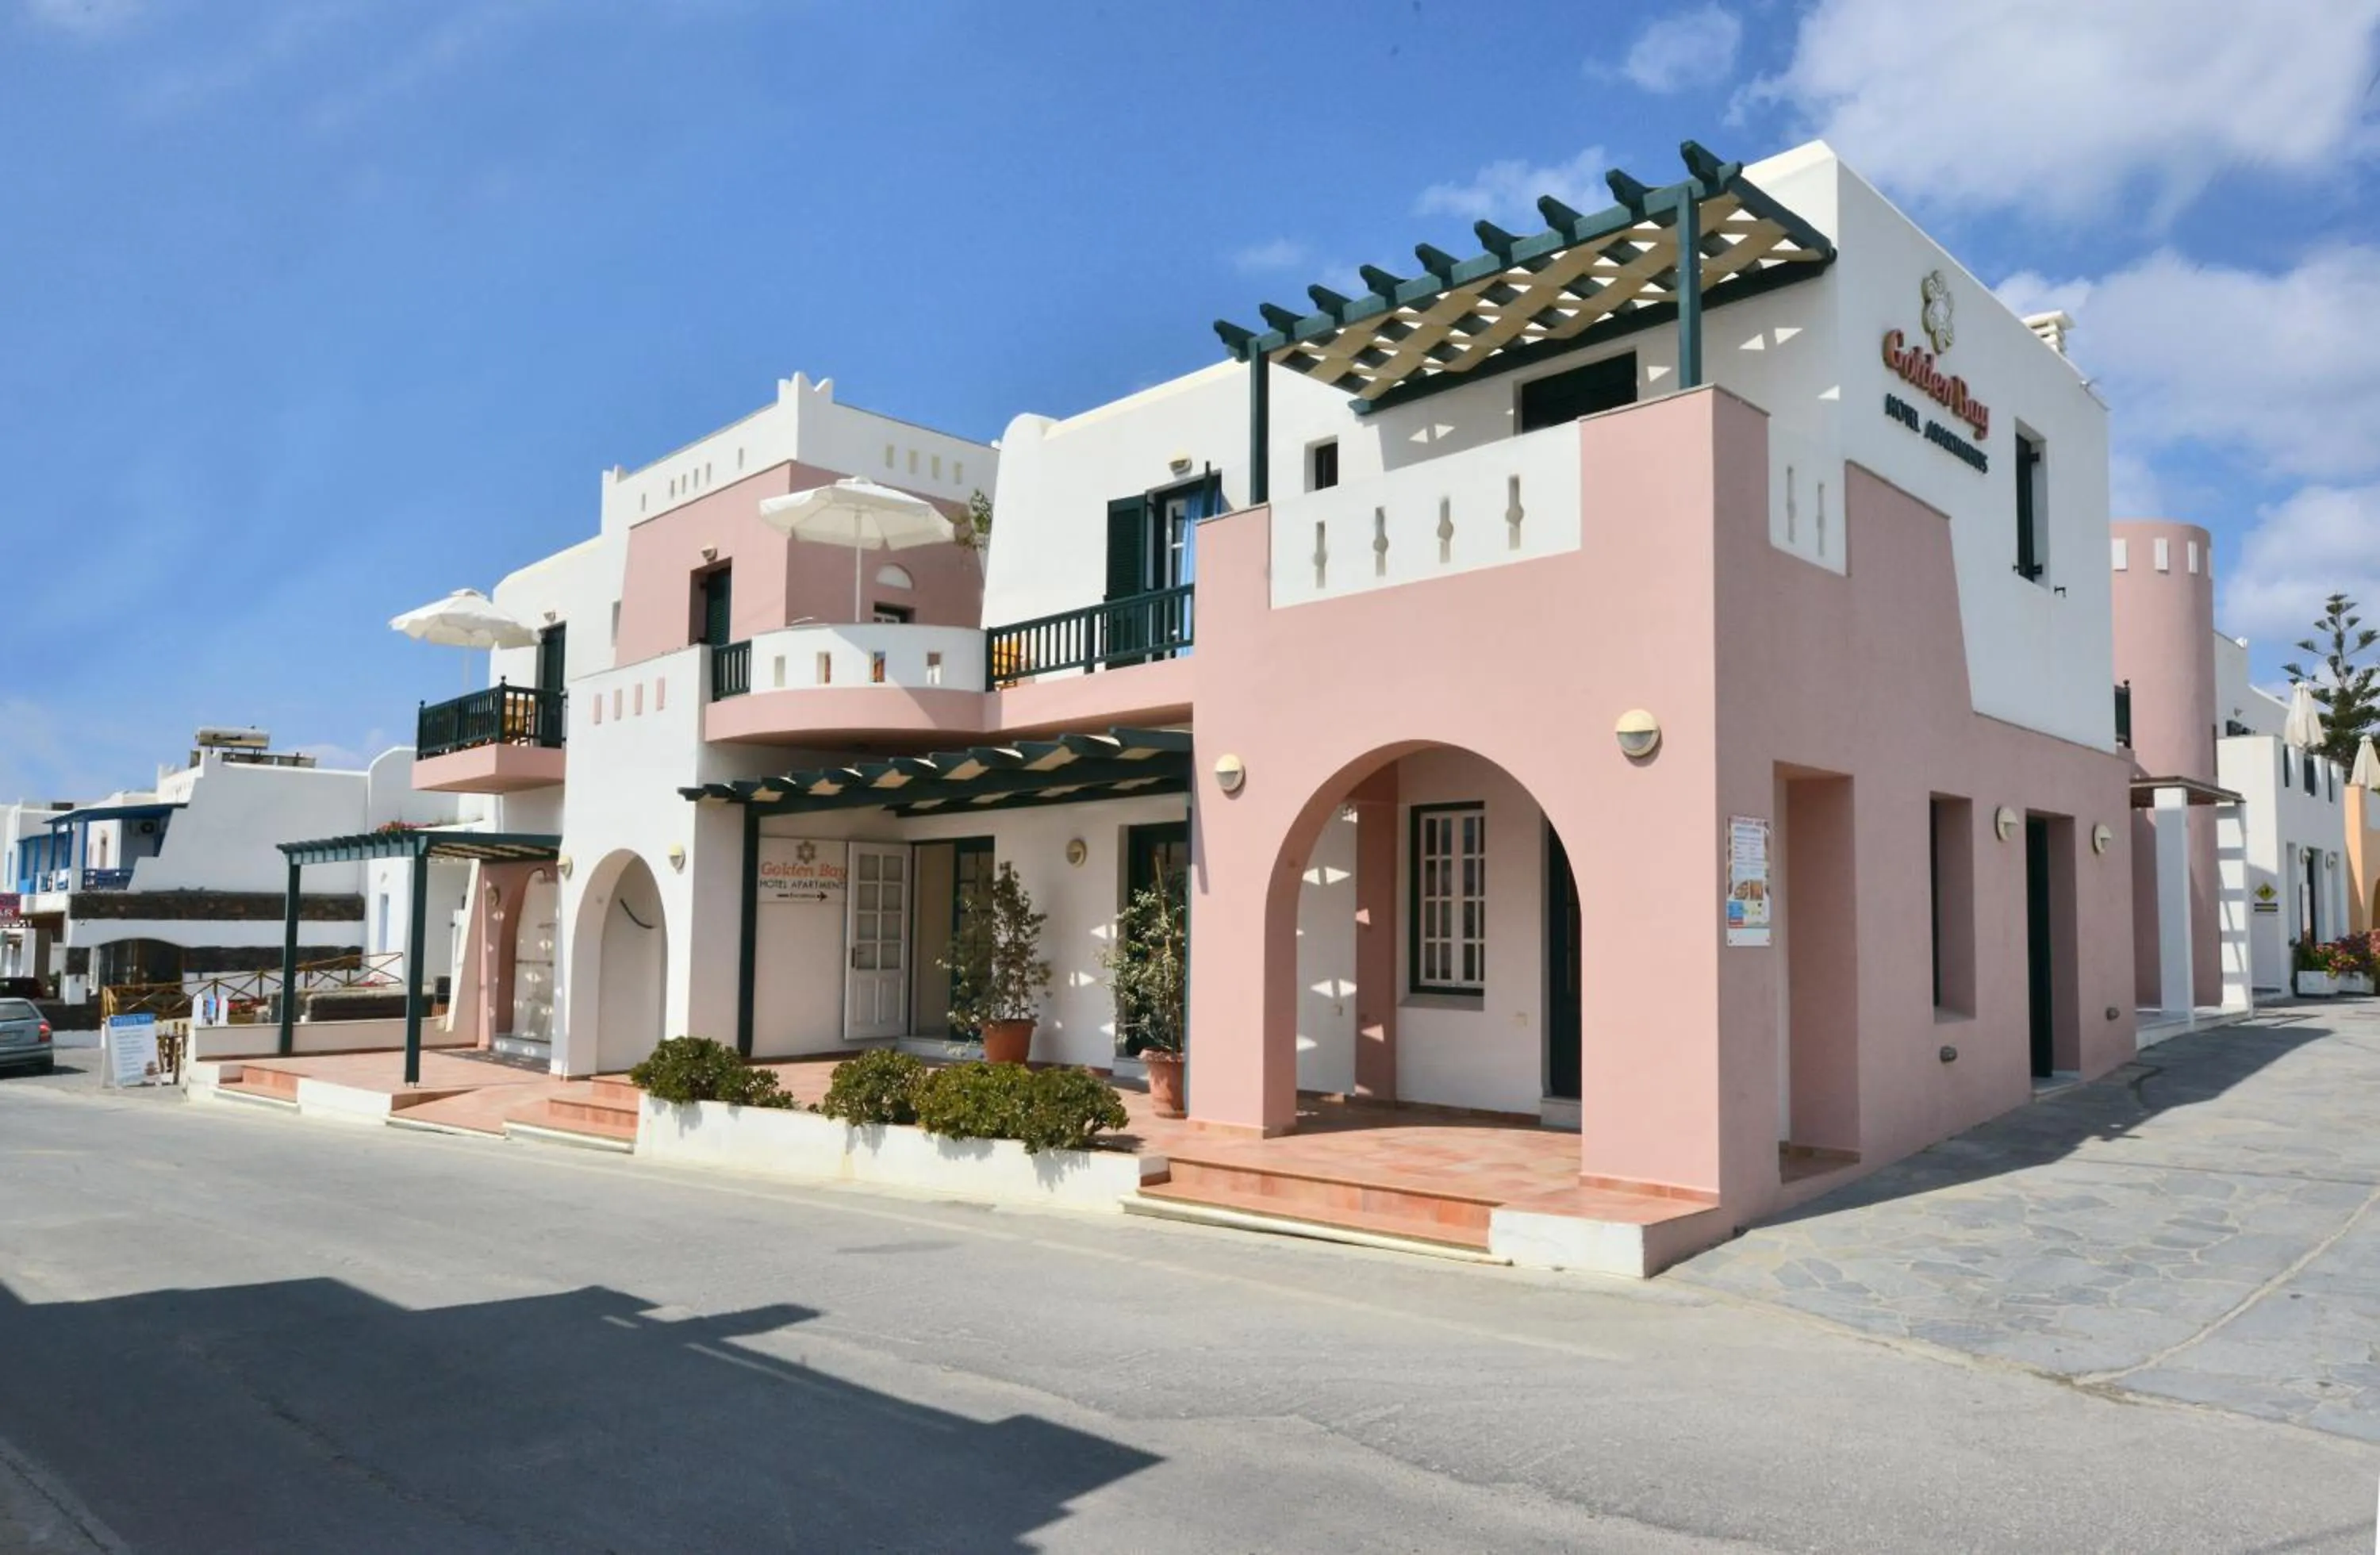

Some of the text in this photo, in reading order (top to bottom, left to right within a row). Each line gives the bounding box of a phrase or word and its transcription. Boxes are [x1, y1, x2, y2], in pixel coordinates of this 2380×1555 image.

[1882, 329, 1989, 440] Golden Bay
[1884, 393, 1921, 432] HOTEL
[760, 879, 786, 889] HOTEL
[762, 861, 847, 883] Golden Bay
